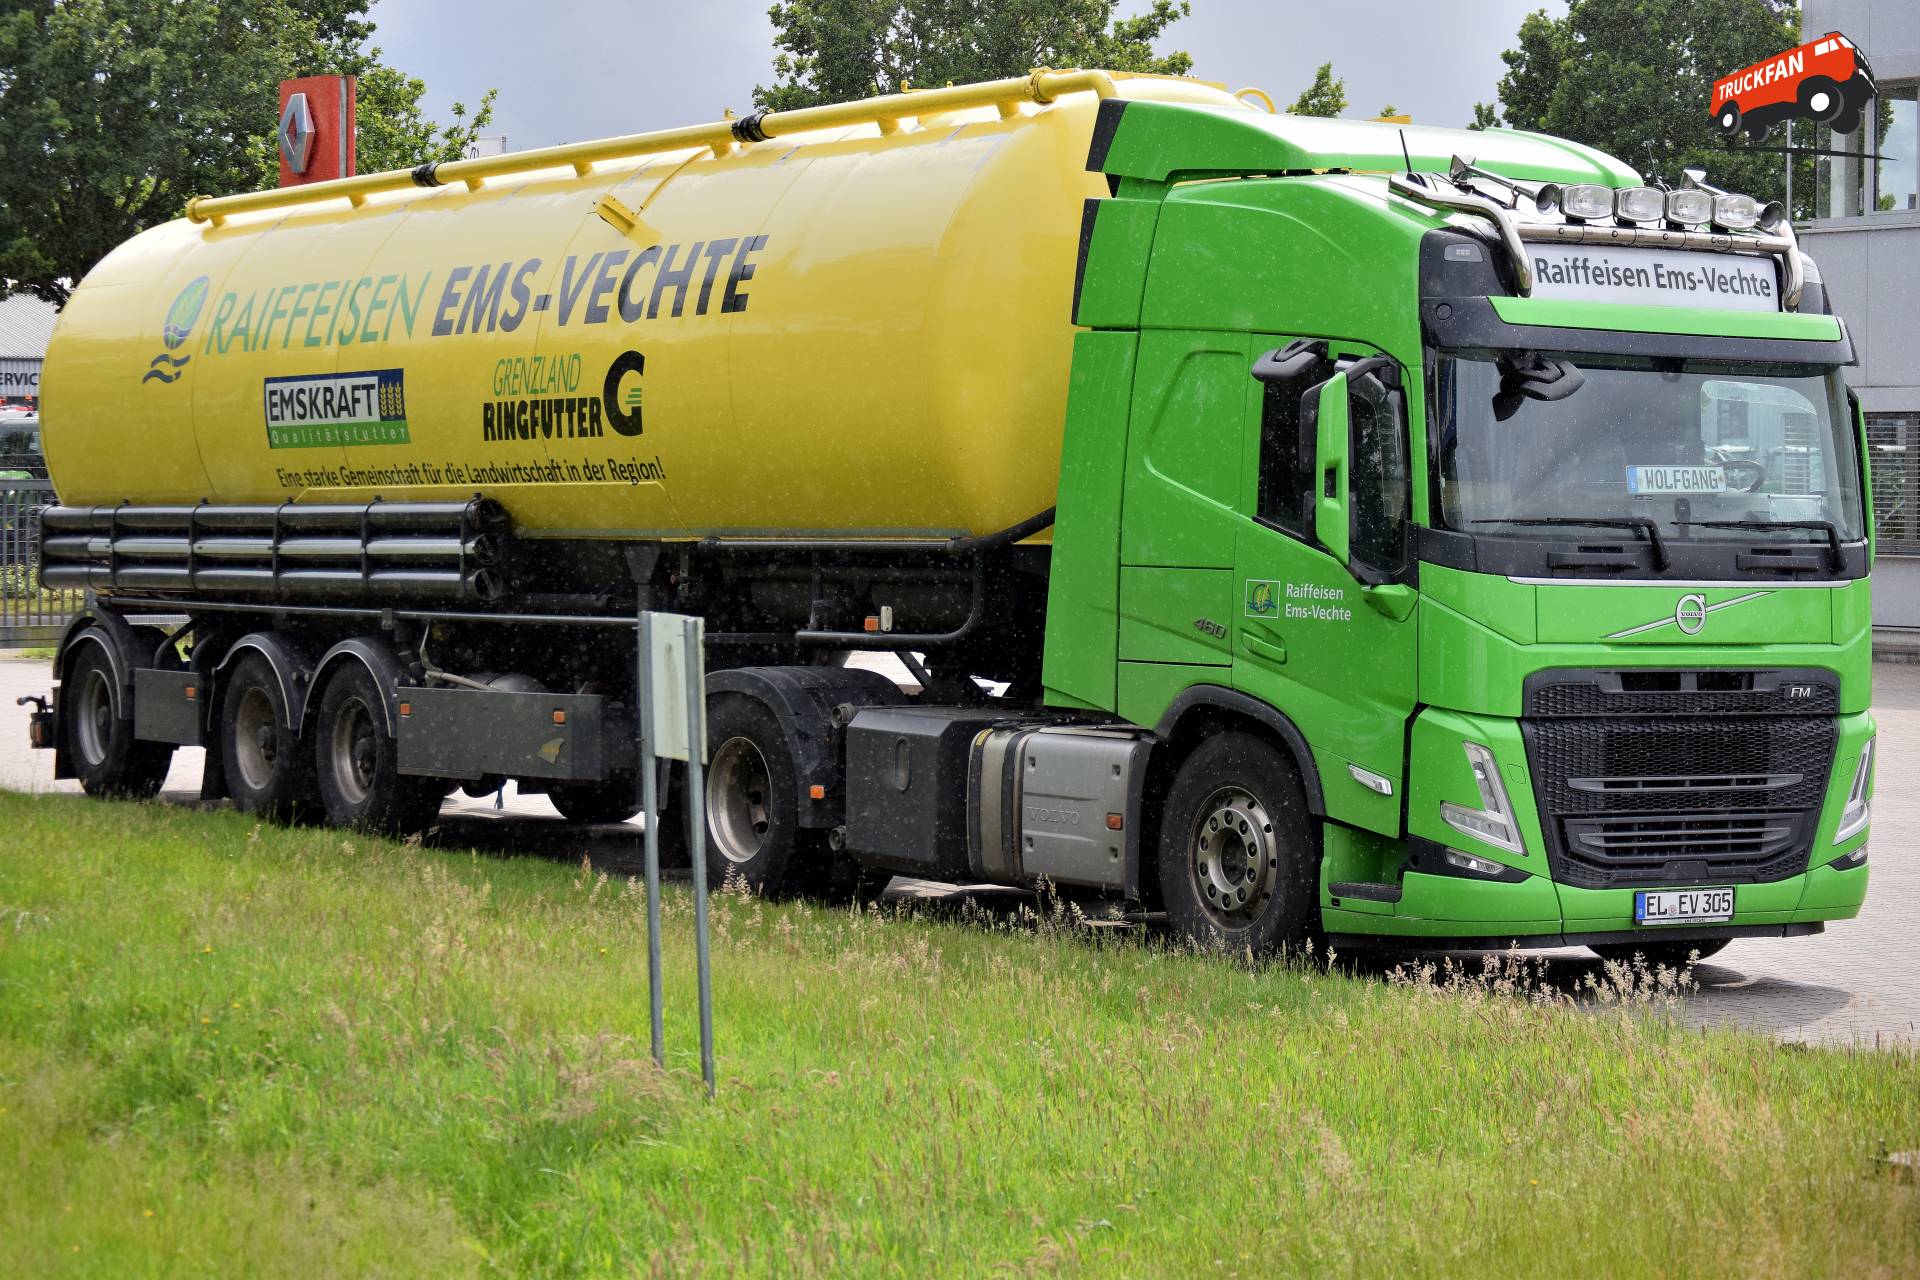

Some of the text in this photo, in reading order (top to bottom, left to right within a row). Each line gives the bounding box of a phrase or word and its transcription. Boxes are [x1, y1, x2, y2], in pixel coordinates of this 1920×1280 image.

[1534, 257, 1771, 297] Raiffeisen Ems-Vechte
[204, 234, 770, 356] RAIFFEISEN EMS-VECHTE
[493, 353, 581, 397] GRENZLAND
[268, 383, 376, 422] EMSKRAFT
[483, 396, 604, 442] RINGFUTTER
[272, 427, 406, 444] Qualitätsfutter
[276, 456, 666, 488] Eine starke Gemeinschaft für die Landwirtschaft in der Region!
[1644, 469, 1719, 490] WOLFGANG
[1286, 583, 1344, 600] Raiffeisen
[1285, 603, 1352, 621] Ems-Vechte
[1193, 617, 1227, 640] 460
[1790, 687, 1811, 698] FM
[1025, 806, 1080, 825] VOLVO
[1646, 892, 1731, 916] EL EV 305
